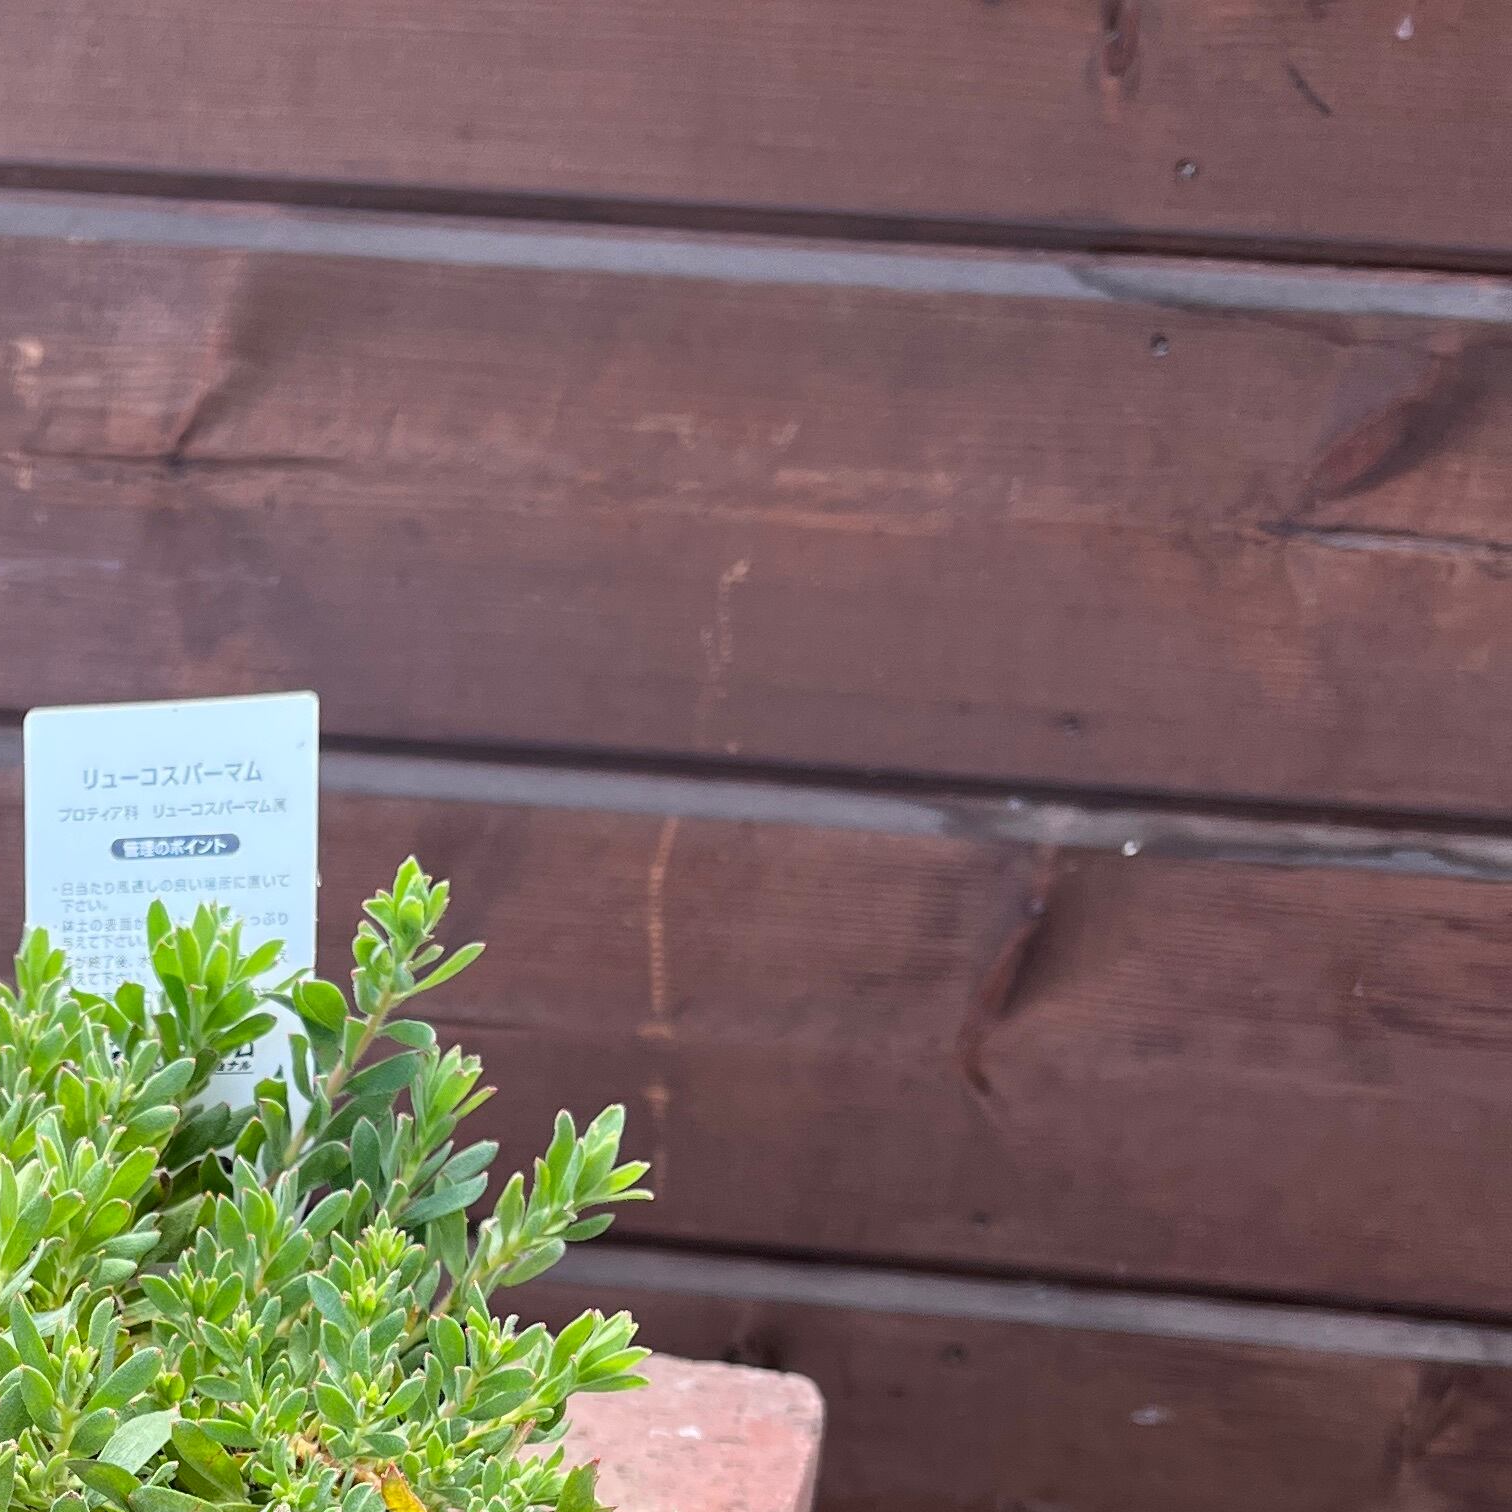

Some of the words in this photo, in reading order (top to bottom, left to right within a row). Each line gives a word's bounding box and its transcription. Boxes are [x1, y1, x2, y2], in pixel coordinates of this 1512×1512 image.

[83, 761, 264, 790] リューコスパーマム
[122, 837, 228, 860] 管理のポイント
